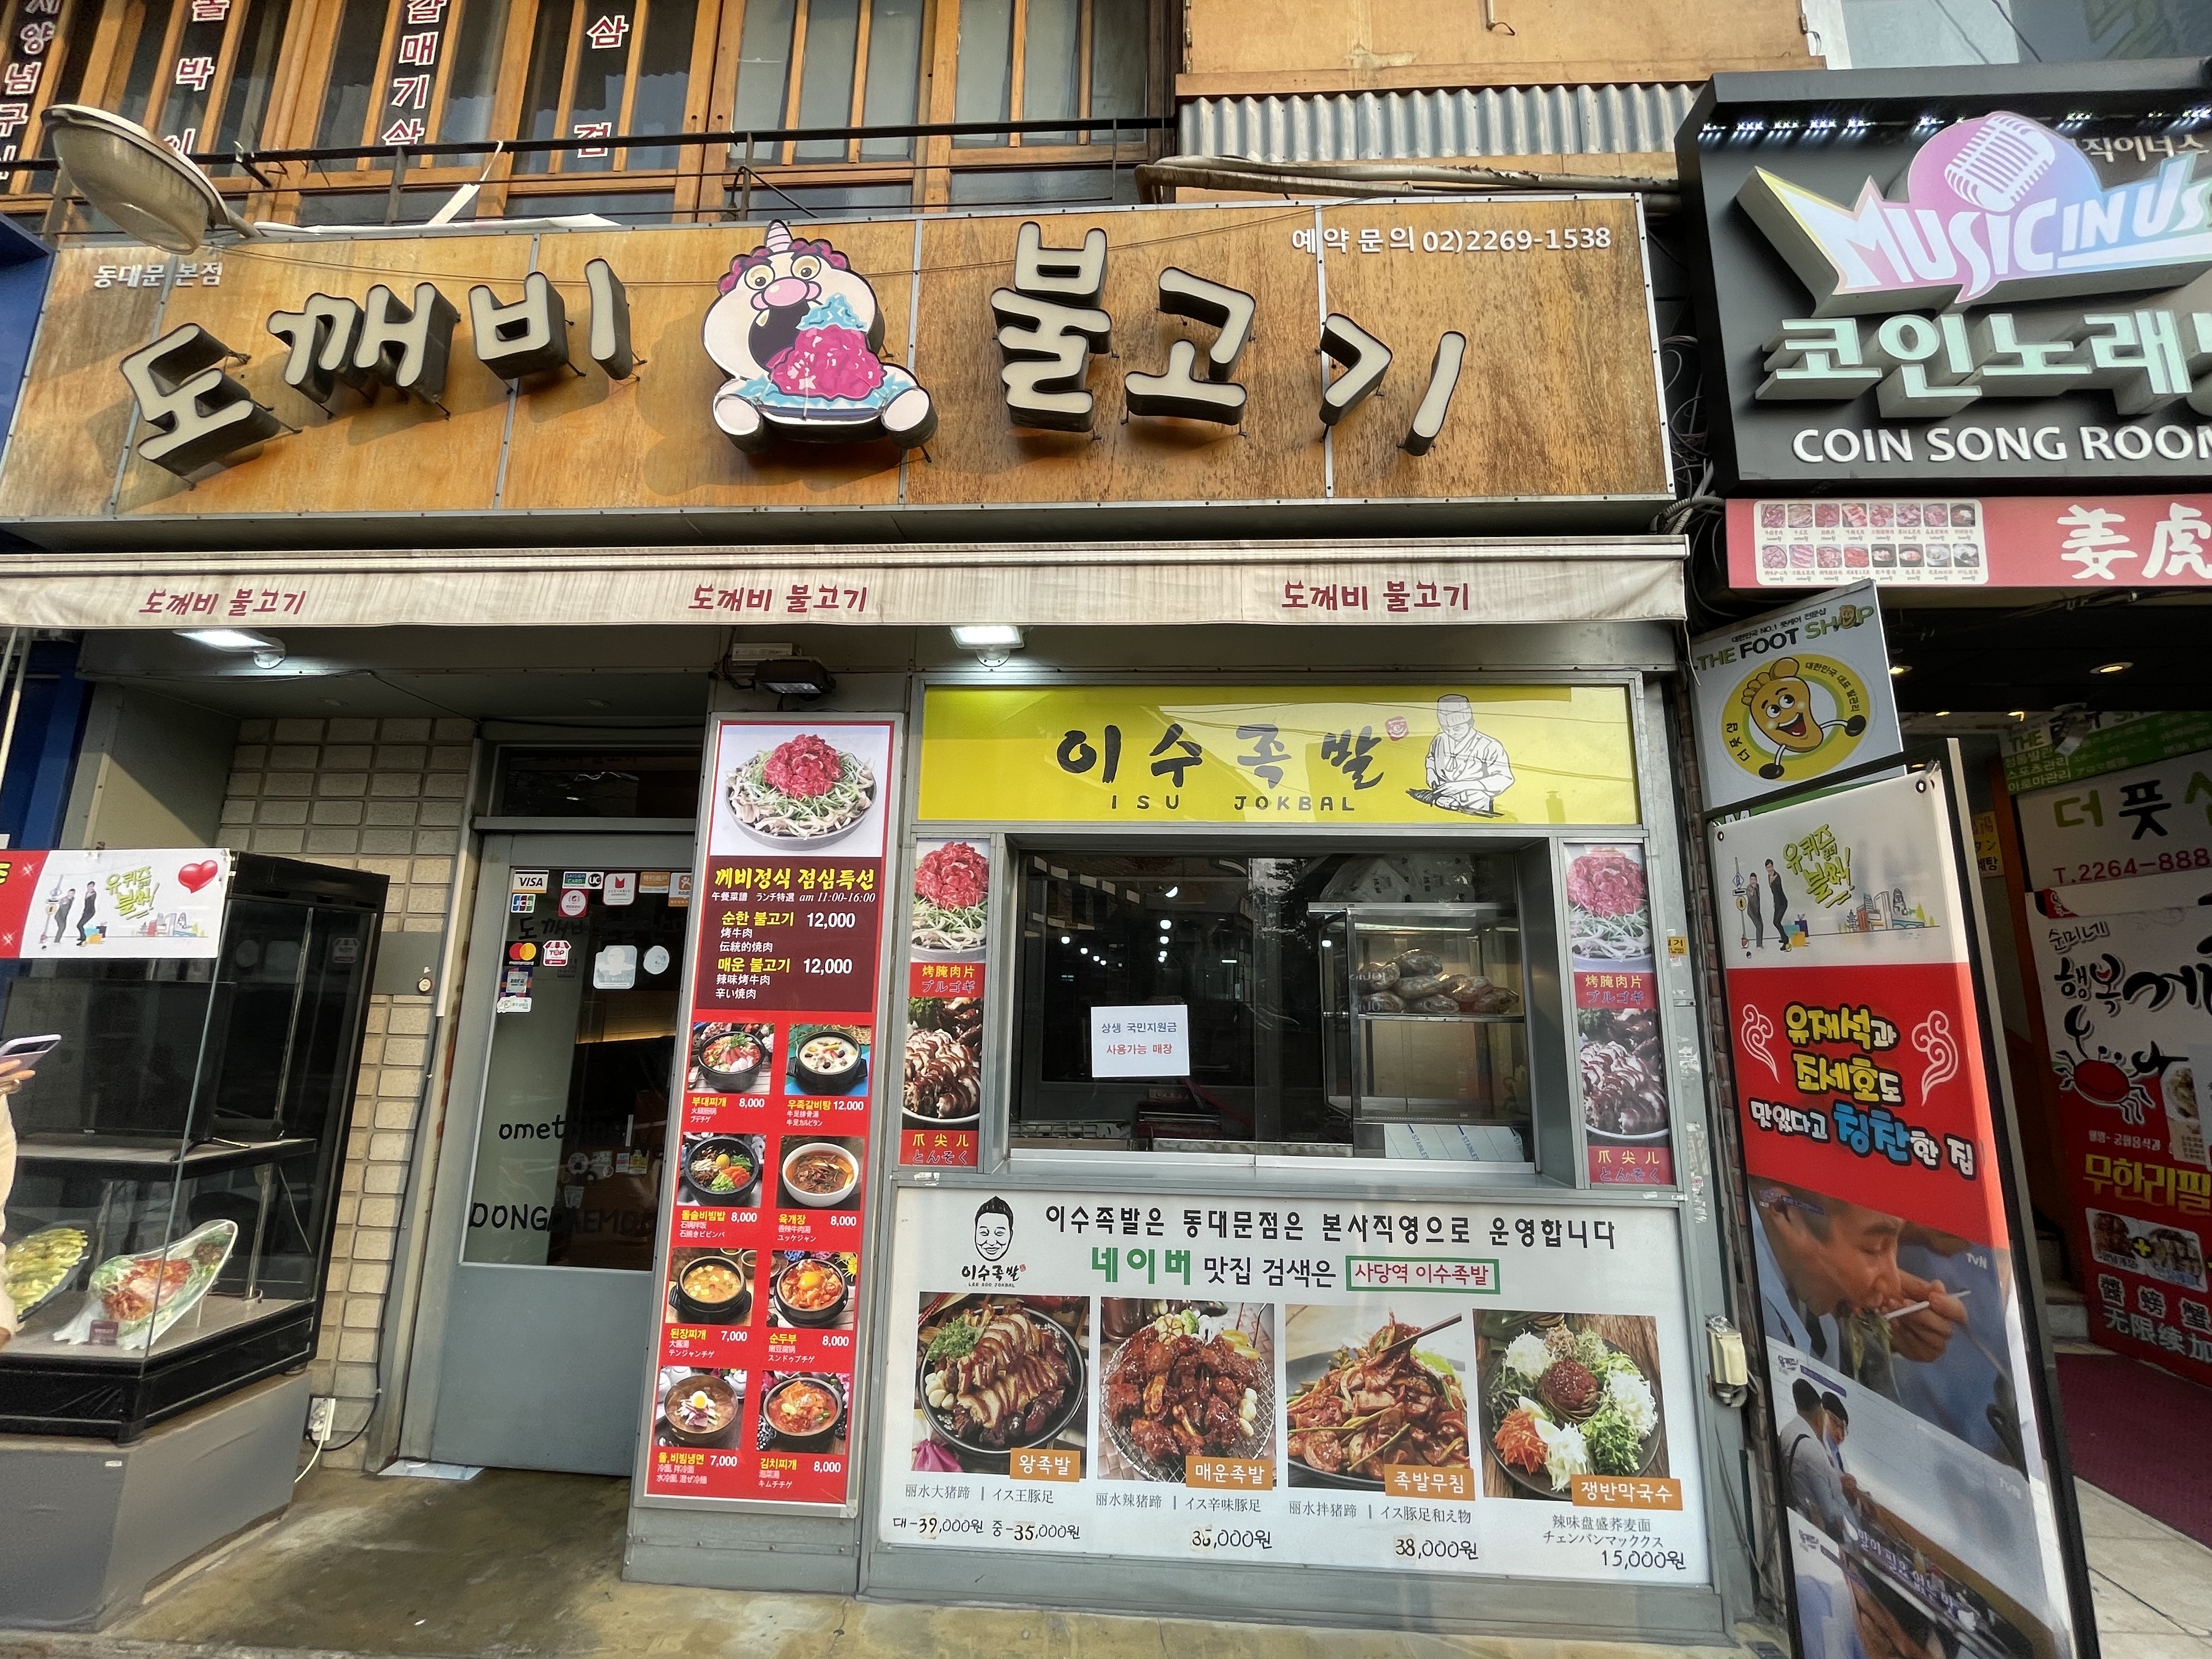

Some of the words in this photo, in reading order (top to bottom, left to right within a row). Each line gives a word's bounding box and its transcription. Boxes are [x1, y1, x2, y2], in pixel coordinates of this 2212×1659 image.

[1292, 228, 1350, 253] 예약
[1358, 227, 1414, 252] 문의
[1423, 227, 1612, 255] 02)2269-1538
[1775, 183, 2057, 298] MUSIC
[93, 264, 166, 288] 동대문
[175, 261, 224, 287] 본점
[120, 258, 628, 466] 도깨비
[990, 221, 1466, 450] 불고기
[1793, 428, 1914, 464] COIN
[1928, 426, 2068, 462] SONG
[139, 589, 219, 616] 도깨비
[228, 587, 308, 617] 불고기
[688, 582, 773, 613] 도깨비
[785, 583, 868, 616] 불고기
[1280, 580, 1370, 613] 도깨비
[1383, 579, 1471, 614] 불고기
[1696, 646, 1735, 671] THE
[1739, 627, 1799, 659] FOOT
[1111, 794, 1181, 811] ISU
[1233, 794, 1356, 813] JOKBAL
[519, 877, 543, 887] VISA
[797, 867, 875, 891] 점심특선
[799, 894, 815, 902] am
[817, 892, 876, 903] 11:00-16:00
[721, 911, 749, 927] 순한
[753, 911, 794, 927] 불고기
[806, 912, 856, 930] 12,000
[720, 927, 753, 939] 烤牛肉
[717, 957, 745, 973] 매운
[749, 957, 791, 974] 불고기
[803, 958, 853, 975] 12,000
[715, 974, 770, 986] 辣味烤牛肉
[1101, 1021, 1122, 1034] 상생
[1126, 1020, 1177, 1034] 국민지원금
[1785, 1004, 1898, 1050] 유재석과
[1106, 1043, 1148, 1056] 사용가능
[1152, 1043, 1173, 1056] 매장
[1792, 1052, 1901, 1103] 조세호도
[691, 1096, 727, 1108] 부대찌개
[738, 1098, 765, 1109] 8,000
[833, 1100, 865, 1112] 12,000
[1750, 1101, 1828, 1140] 맛있다고
[1833, 1103, 1939, 1166] 칭찬한
[1946, 1137, 1974, 1176] 집
[730, 1211, 758, 1223] 8,000
[778, 1214, 806, 1225] 육개장
[830, 1216, 857, 1227] 8,000
[1046, 1205, 1165, 1238] 이수족발은
[1182, 1208, 1303, 1240] 동대문점은
[1322, 1213, 1470, 1245] 본사직영으로
[1488, 1216, 1616, 1250] 운영합니다
[1091, 1245, 1192, 1286] 네이버
[1204, 1256, 1252, 1288] 맛집
[1262, 1258, 1336, 1289] 검색은
[1354, 1262, 1408, 1285] 사당역
[1414, 1263, 1489, 1288] 이수족발
[669, 1328, 707, 1341] 된장찌개
[720, 1330, 748, 1342] 7,000
[768, 1333, 797, 1345] 순두부
[822, 1335, 850, 1347] 8,000
[709, 1455, 738, 1467] 7,000
[760, 1458, 797, 1471] 김치찌개
[813, 1461, 842, 1474] 8,000
[1018, 1454, 1072, 1476] 왕족발
[1194, 1462, 1266, 1485] 매운족발
[1394, 1470, 1465, 1494] 족발무침
[904, 1483, 970, 1500] 丽水大猪蹄
[992, 1487, 1054, 1504] イス王豚足
[1581, 1481, 1673, 1504] 쟁반막국수
[1184, 1497, 1262, 1513] イス辛味豚足
[1380, 1506, 1472, 1524] イス豚足和え物
[1394, 1538, 1478, 1561] 38,000원
[1601, 1550, 1686, 1571] 15,000원
